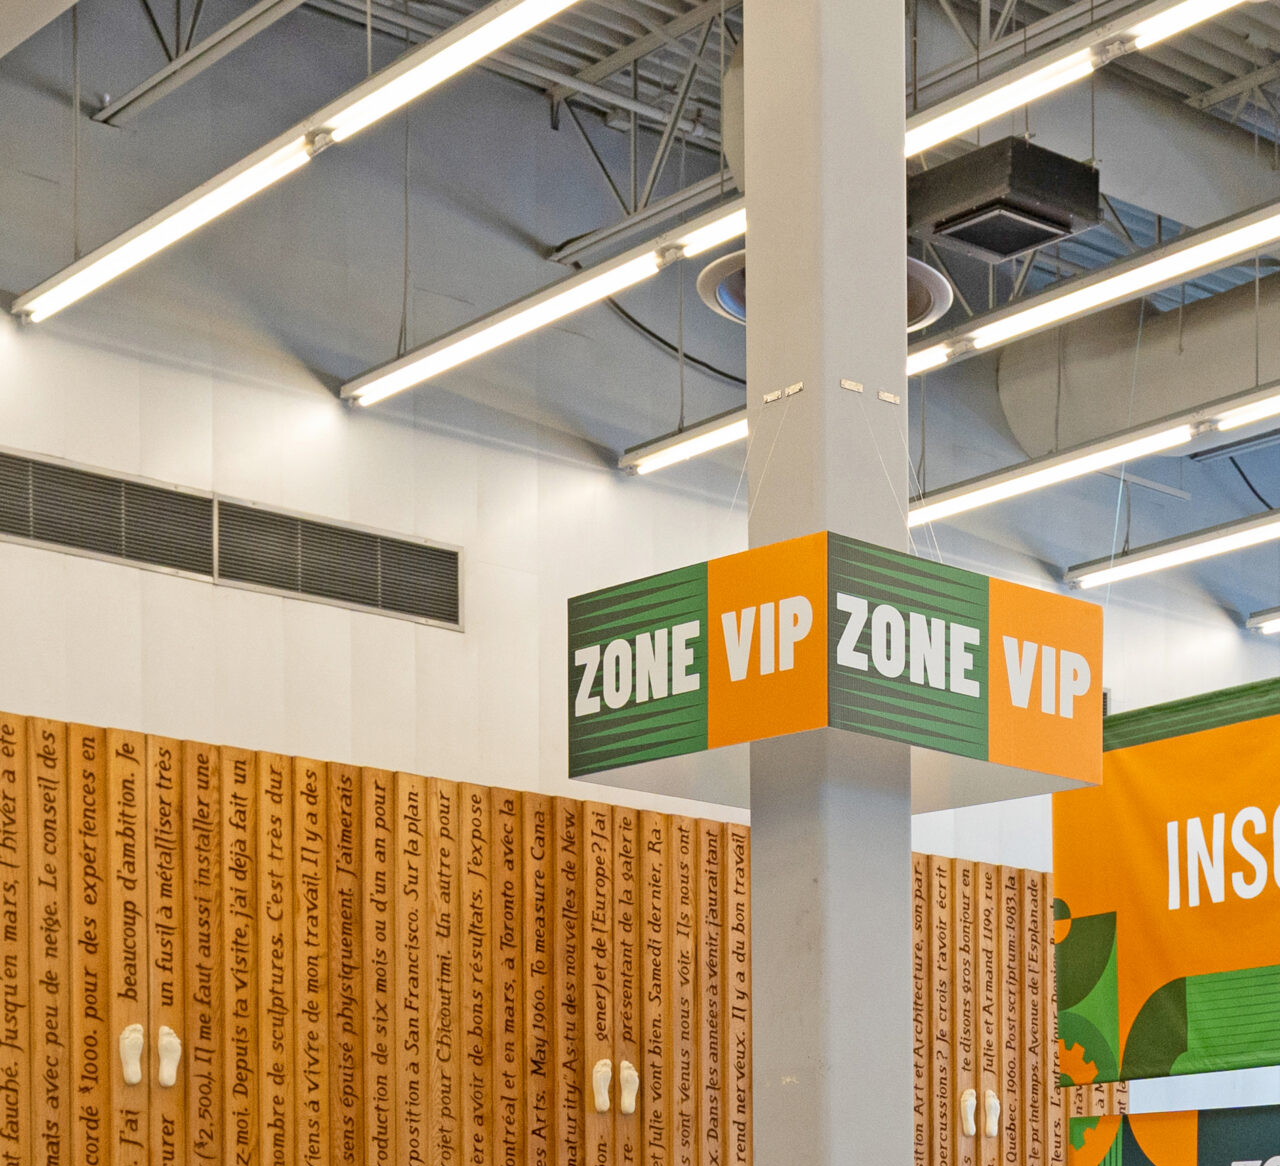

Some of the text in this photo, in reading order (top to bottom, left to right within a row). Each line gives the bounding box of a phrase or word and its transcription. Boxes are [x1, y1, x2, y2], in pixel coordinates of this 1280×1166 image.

[574, 595, 814, 717] ZONE VIP
[836, 592, 1092, 719] ZONE VIP
[36, 729, 57, 769] des
[81, 736, 95, 761] en
[115, 742, 140, 765] Je
[154, 746, 173, 790] très
[36, 775, 60, 855] conseil
[115, 772, 138, 891] d'ambition.
[335, 773, 357, 878] J'aimerais
[403, 784, 423, 836] plan-
[439, 789, 455, 841] pour
[530, 802, 545, 860] Cana-
[561, 807, 577, 855] New
[78, 768, 103, 905] expériences
[154, 793, 174, 898] métalliser
[403, 838, 421, 856] la
[467, 792, 487, 880] J'expose
[37, 862, 57, 891] Le
[402, 858, 419, 901] Sur
[437, 846, 452, 904] autre
[561, 859, 576, 881] de
[731, 831, 746, 895] travail
[962, 868, 970, 886] en
[984, 871, 993, 900] rue
[1004, 875, 1016, 890] la
[935, 864, 947, 909] écrit
[39, 900, 61, 958] neige.
[155, 904, 173, 919] à
[435, 912, 451, 938] Un
[534, 868, 545, 952] measure
[561, 886, 578, 975] nouvelles
[731, 901, 745, 934] bon
[958, 890, 973, 954] bonjour
[1027, 878, 1040, 974] l'Esplanade
[77, 915, 99, 954] des
[116, 899, 141, 1002] beaucoup
[154, 922, 176, 974] fusil
[467, 888, 486, 984] résultats.
[591, 936, 607, 958] de
[731, 939, 746, 962] du
[38, 968, 60, 994] de
[336, 887, 359, 1034] physiquement.
[403, 908, 420, 1013] Francisco.
[530, 959, 546, 977] To
[593, 961, 607, 980] et
[735, 970, 745, 982] a
[962, 957, 972, 993] gros
[981, 947, 994, 1016] Armand
[83, 964, 104, 1021] pour
[160, 980, 174, 1006] un
[436, 949, 452, 1062] Chicoutimi.
[532, 984, 545, 1030] 1960.
[561, 980, 576, 1014] des
[676, 824, 691, 1148] sont venus nous voir. Ils nous ont
[936, 978, 947, 1022] crois
[1028, 976, 1039, 995] de
[45, 1004, 64, 1047] peu
[403, 1016, 419, 1055] San
[466, 988, 483, 1038] bons
[731, 1005, 747, 1022] Il
[936, 1028, 949, 1042] Je
[959, 997, 971, 1052] disons
[983, 1018, 993, 1034] et
[1028, 998, 1039, 1056] Avenue
[405, 1061, 419, 1074] à
[467, 1044, 484, 1066] de
[530, 1035, 548, 1077] May
[562, 1020, 577, 1072] As-tu
[961, 1056, 971, 1071] te
[983, 1038, 996, 1074] Julie
[42, 1054, 59, 1109] avec
[338, 1042, 358, 1107] épuisé
[440, 1068, 456, 1120] pour
[734, 1030, 746, 1114] nerveux.
[1006, 1056, 1016, 1094] 1960.
[468, 1071, 484, 1126] avoir
[531, 1090, 546, 1140] Arts.
[1029, 1060, 1041, 1143] printemps.
[119, 1108, 144, 1148] J'ai
[342, 1114, 354, 1162] sens
[732, 1119, 746, 1162] rend
[1028, 1146, 1040, 1159] le
